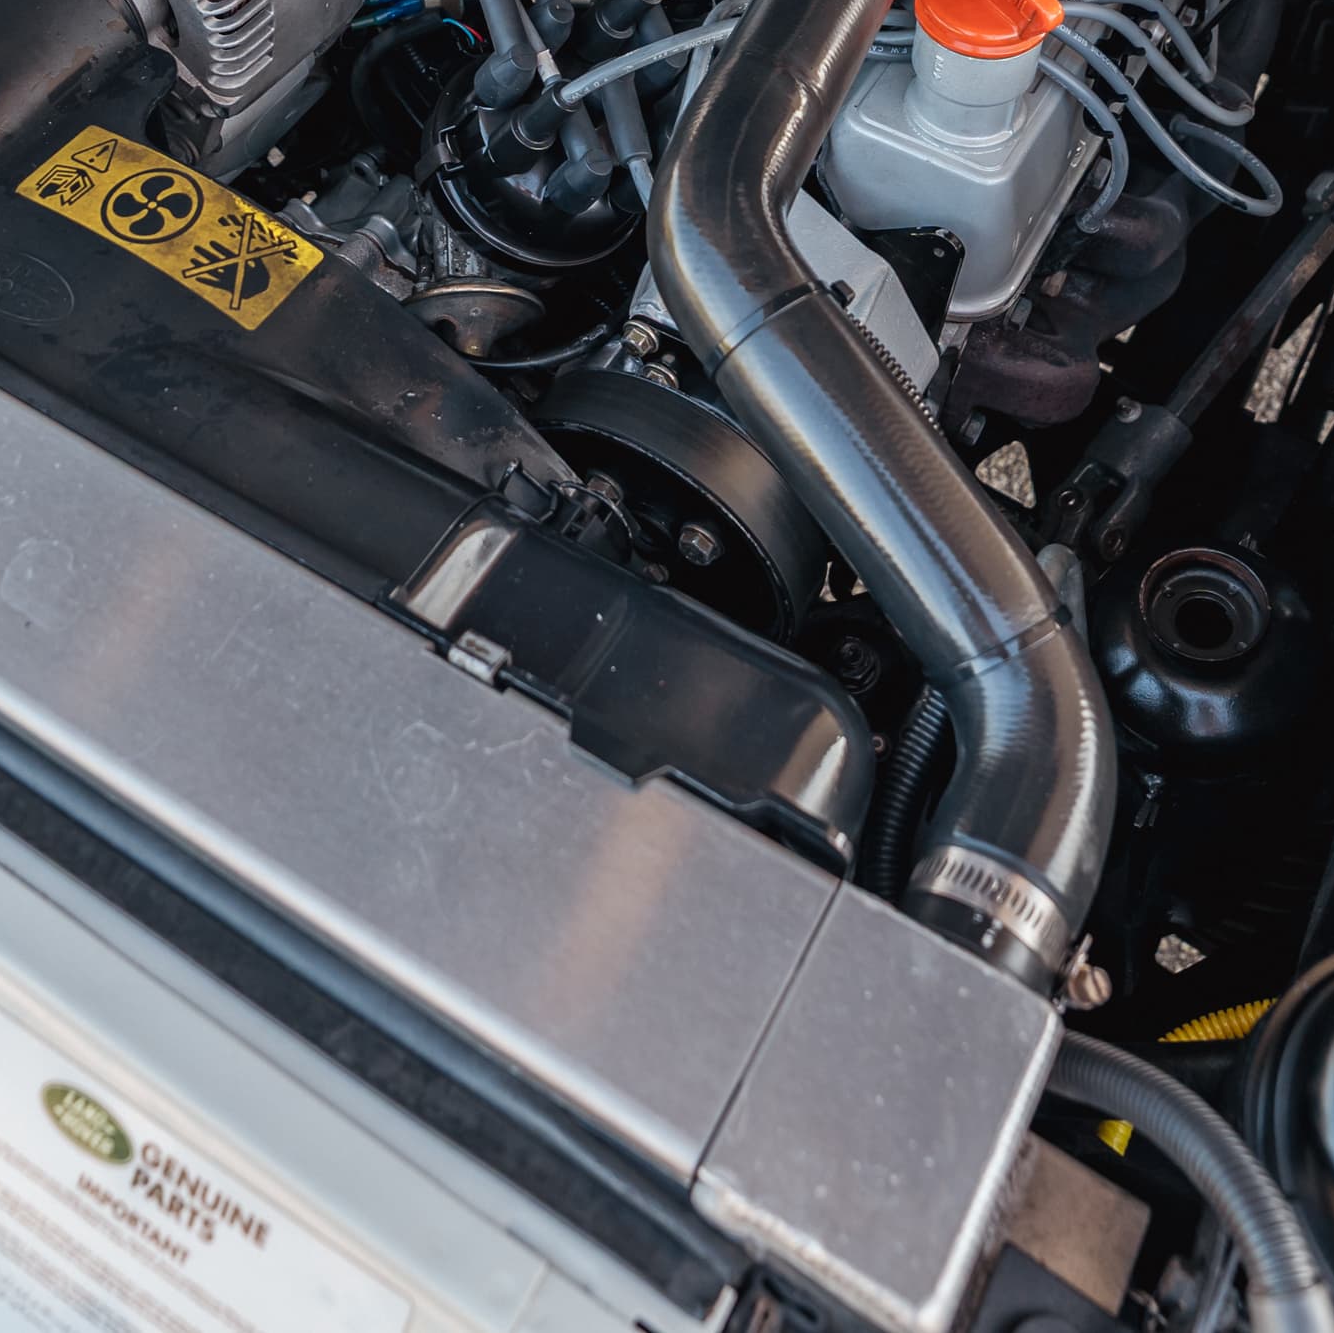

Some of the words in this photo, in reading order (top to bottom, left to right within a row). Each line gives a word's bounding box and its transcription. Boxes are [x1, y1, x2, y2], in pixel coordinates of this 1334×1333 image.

[77, 1172, 190, 1264] IMPORTANT
[132, 1168, 218, 1243] PARTS
[141, 1141, 271, 1250] GENUINE
